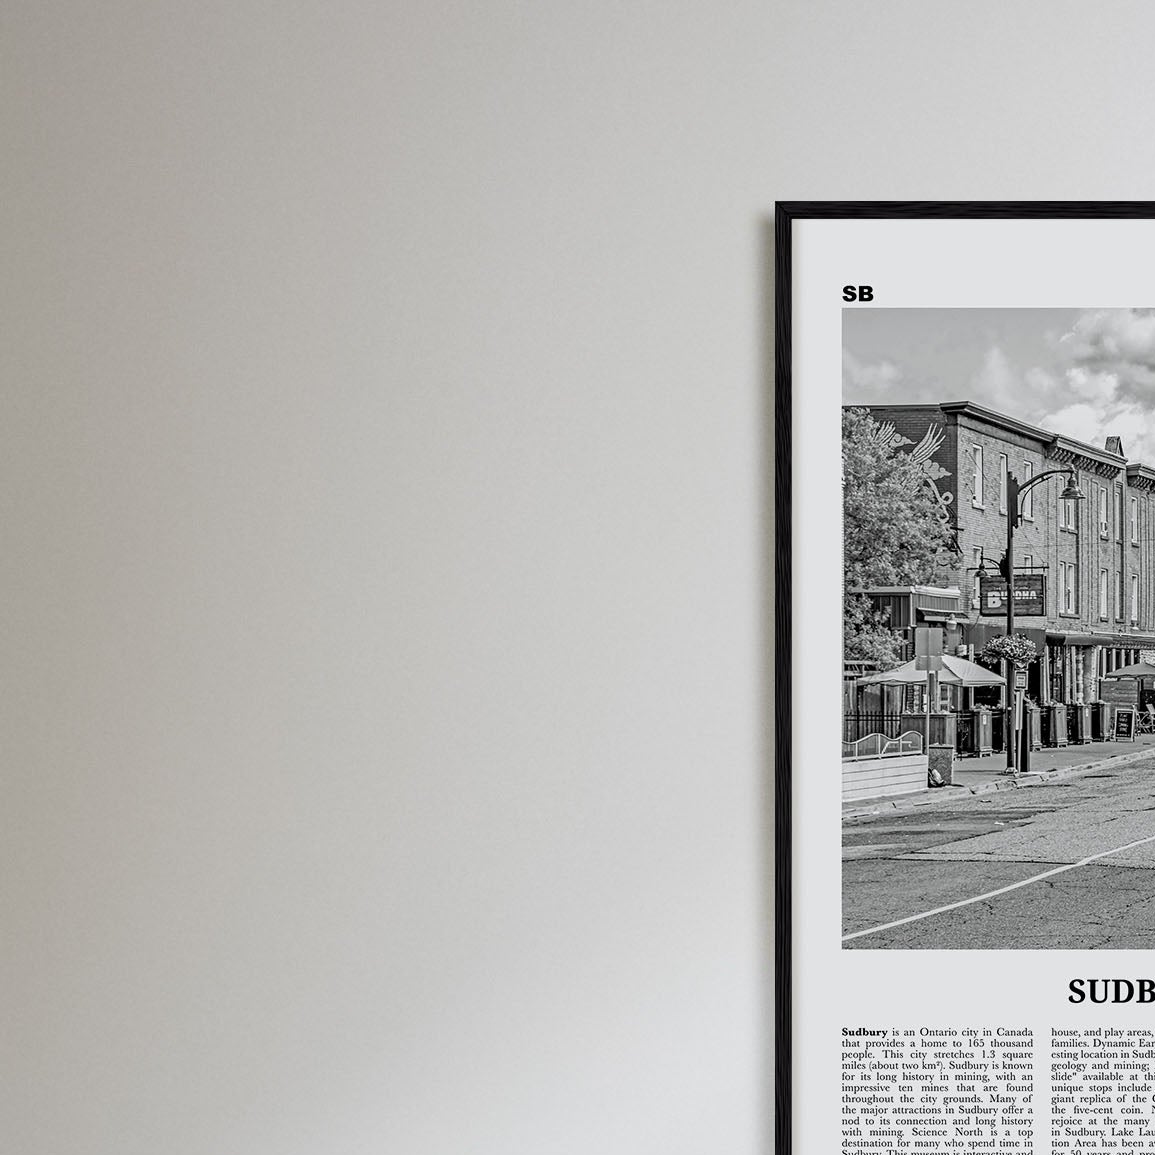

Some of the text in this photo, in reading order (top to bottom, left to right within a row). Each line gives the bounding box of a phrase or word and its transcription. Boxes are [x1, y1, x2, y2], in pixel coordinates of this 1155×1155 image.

[842, 285, 874, 302] SB
[987, 590, 1037, 608] BUDHA
[842, 1028, 888, 1038] Sudbury
[892, 1028, 900, 1036] is
[920, 1028, 957, 1036] Ontario
[961, 1028, 979, 1038] city
[983, 1028, 992, 1036] in
[996, 1028, 1033, 1036] Canada
[1051, 1028, 1081, 1037] house,
[1084, 1028, 1102, 1036] and
[1104, 1028, 1124, 1038] play
[842, 1050, 1033, 1060] people. This city stretches 1.3 square
[1051, 1050, 1079, 1060] esting
[1081, 1050, 1118, 1058] location
[1121, 1050, 1130, 1058] in
[842, 1072, 855, 1080] for
[860, 1072, 872, 1080] its
[876, 1072, 897, 1083] long
[902, 1072, 935, 1083] history
[940, 1072, 949, 1080] in
[955, 1072, 990, 1083] mining,
[995, 1072, 1016, 1080] with
[1051, 1072, 1077, 1080] slide"
[1082, 1072, 1124, 1080] available
[1129, 1072, 1138, 1080] at
[842, 1094, 1033, 1105] throughout the city grounds. Many of
[1051, 1094, 1075, 1105] giant
[1080, 1094, 1112, 1105] replica
[1116, 1094, 1127, 1102] of
[1132, 1094, 1147, 1102] the
[842, 1116, 1034, 1127] nod to its connection and long history
[1051, 1117, 1082, 1127] rejoice
[1088, 1117, 1097, 1125] at
[1103, 1117, 1118, 1125] the
[1124, 1119, 1150, 1127] many
[841, 1139, 1033, 1149] destination for many who spend time in
[1051, 1139, 1069, 1147] tion
[1074, 1139, 1097, 1147] Area
[1101, 1139, 1117, 1147] has
[1121, 1139, 1144, 1147] been
